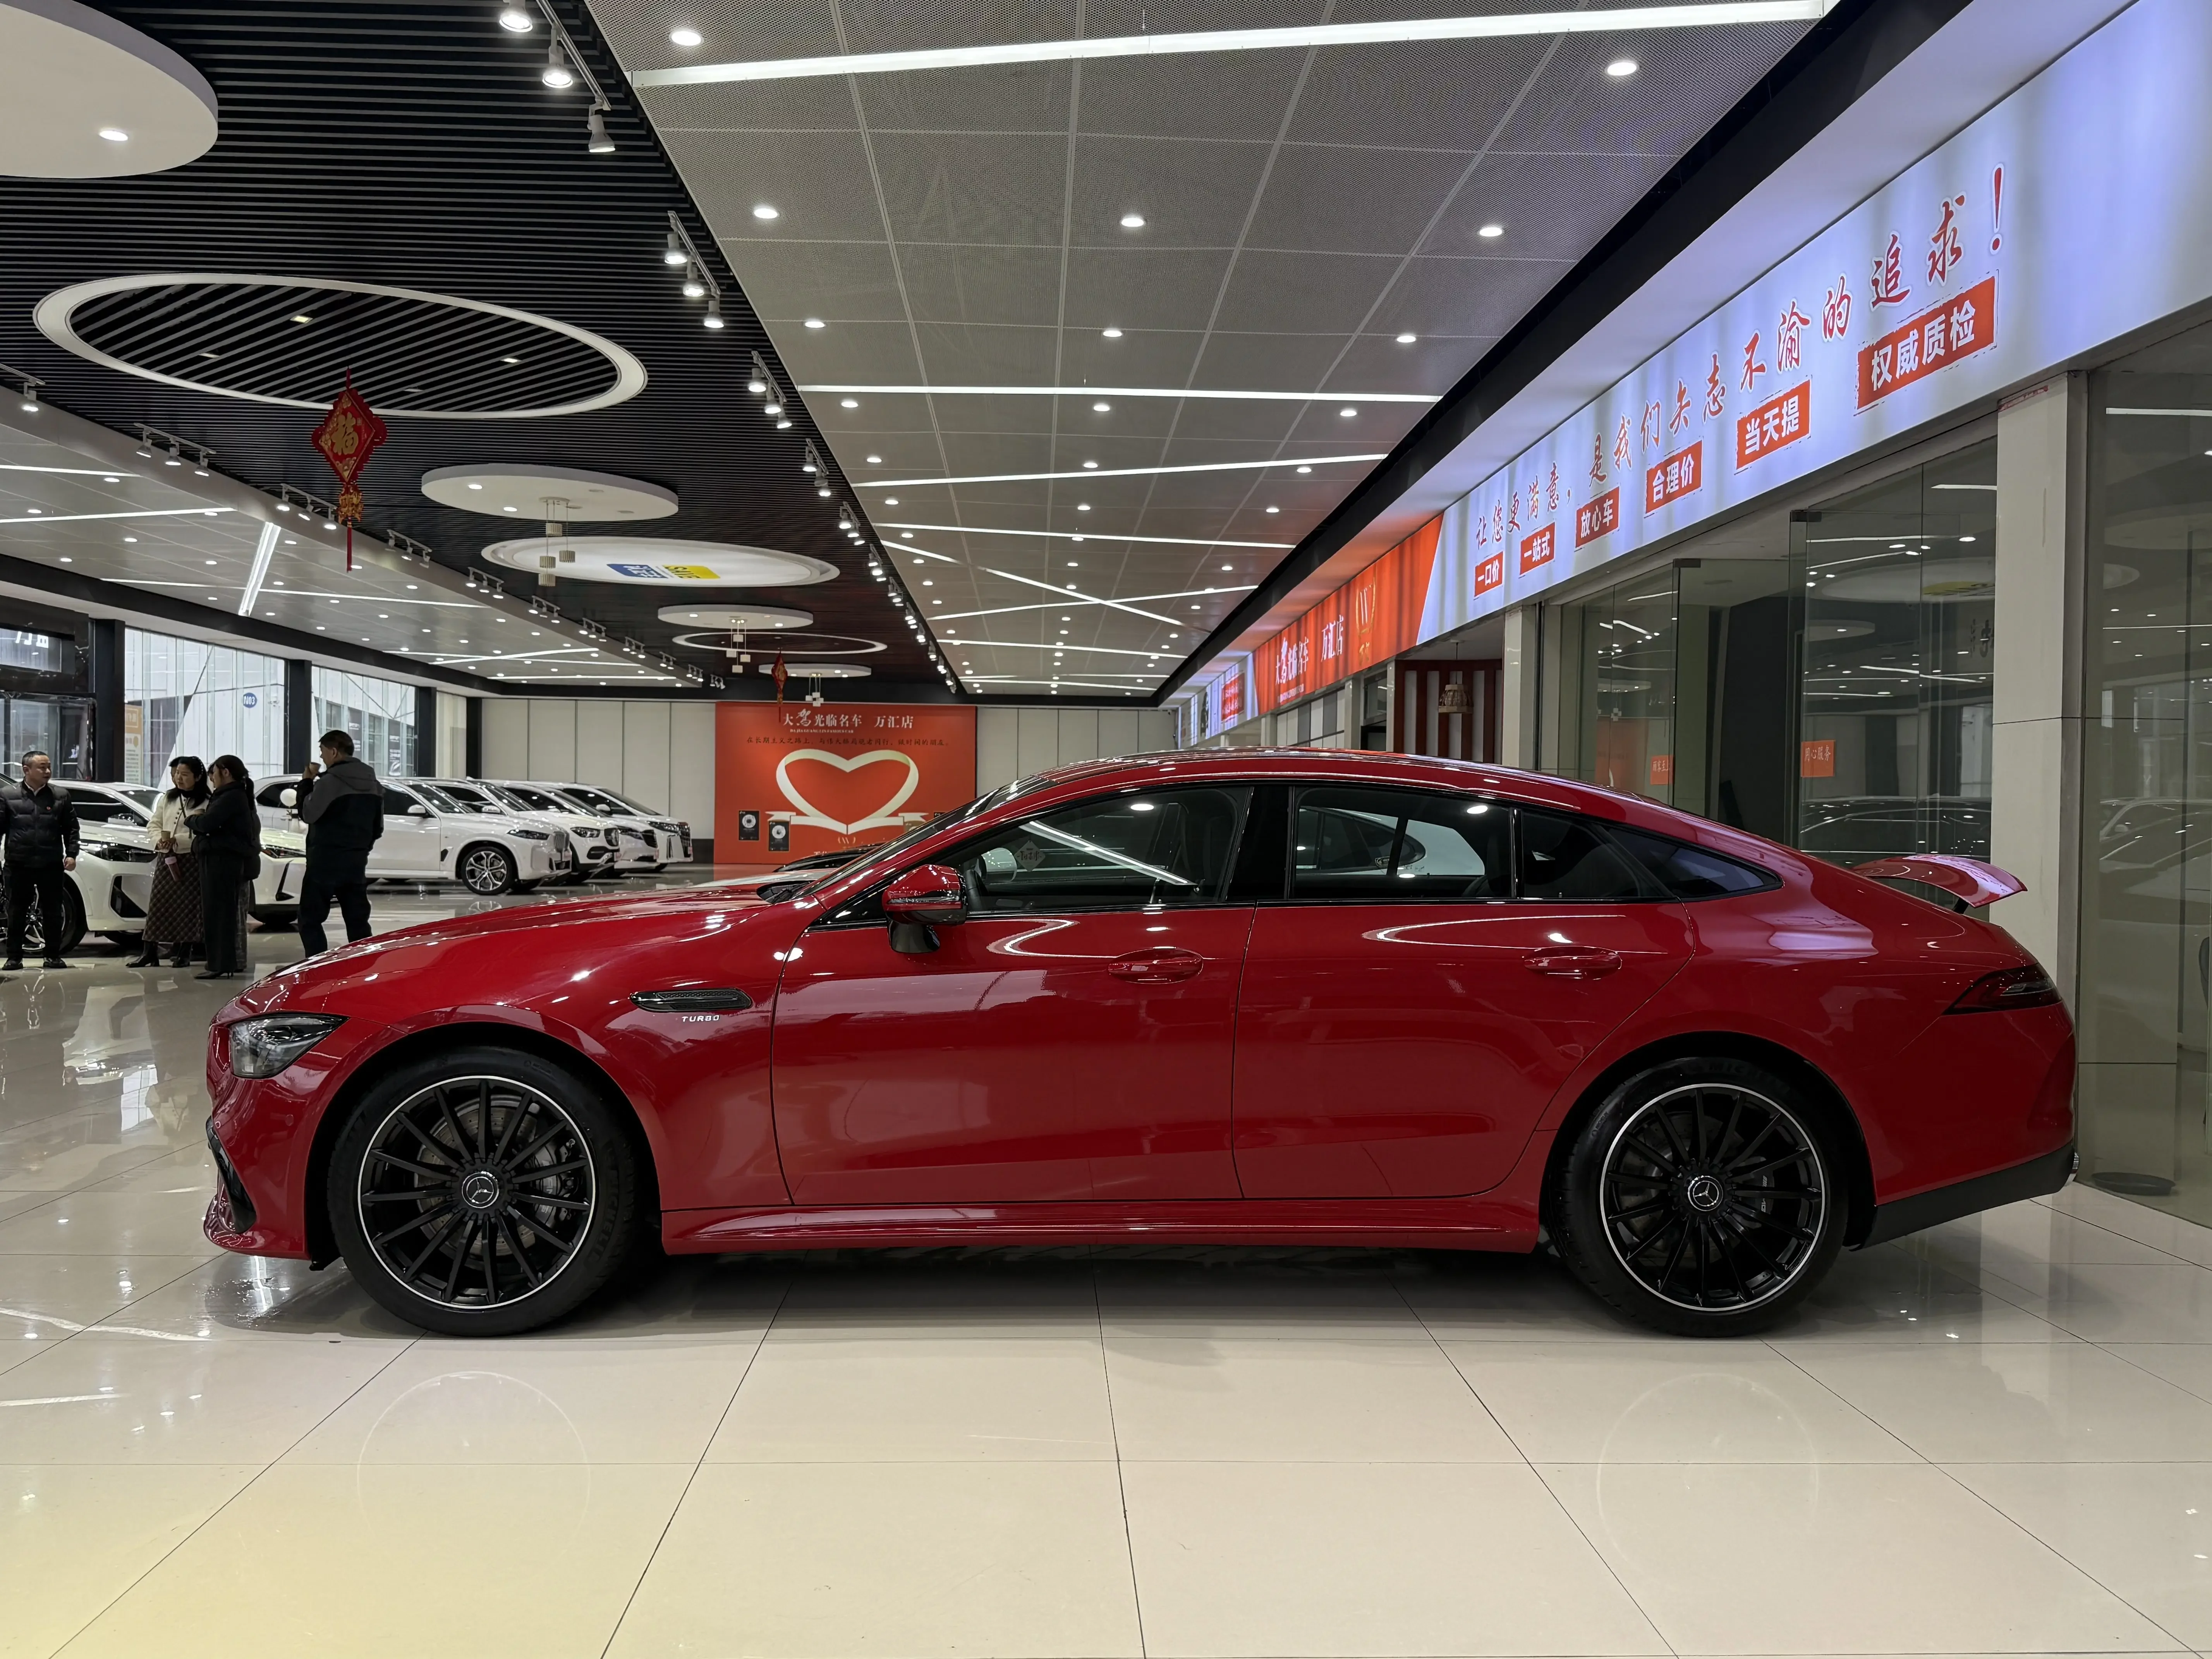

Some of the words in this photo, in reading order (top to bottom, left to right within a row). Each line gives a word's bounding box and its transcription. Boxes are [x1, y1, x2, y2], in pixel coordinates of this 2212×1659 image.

[1871, 300, 1976, 391] 权威质检
[331, 412, 359, 455] 福
[1745, 395, 1800, 455] 当天提
[1652, 453, 1694, 503] 合理价
[1581, 499, 1613, 538] 放心车
[1524, 531, 1550, 562] 一站式
[1477, 559, 1499, 586] 一口价
[1321, 614, 1344, 663] 万汇店
[783, 708, 862, 727] 大驾光临名车
[874, 715, 914, 728] 万汇店
[1805, 745, 1831, 762] 用心服务
